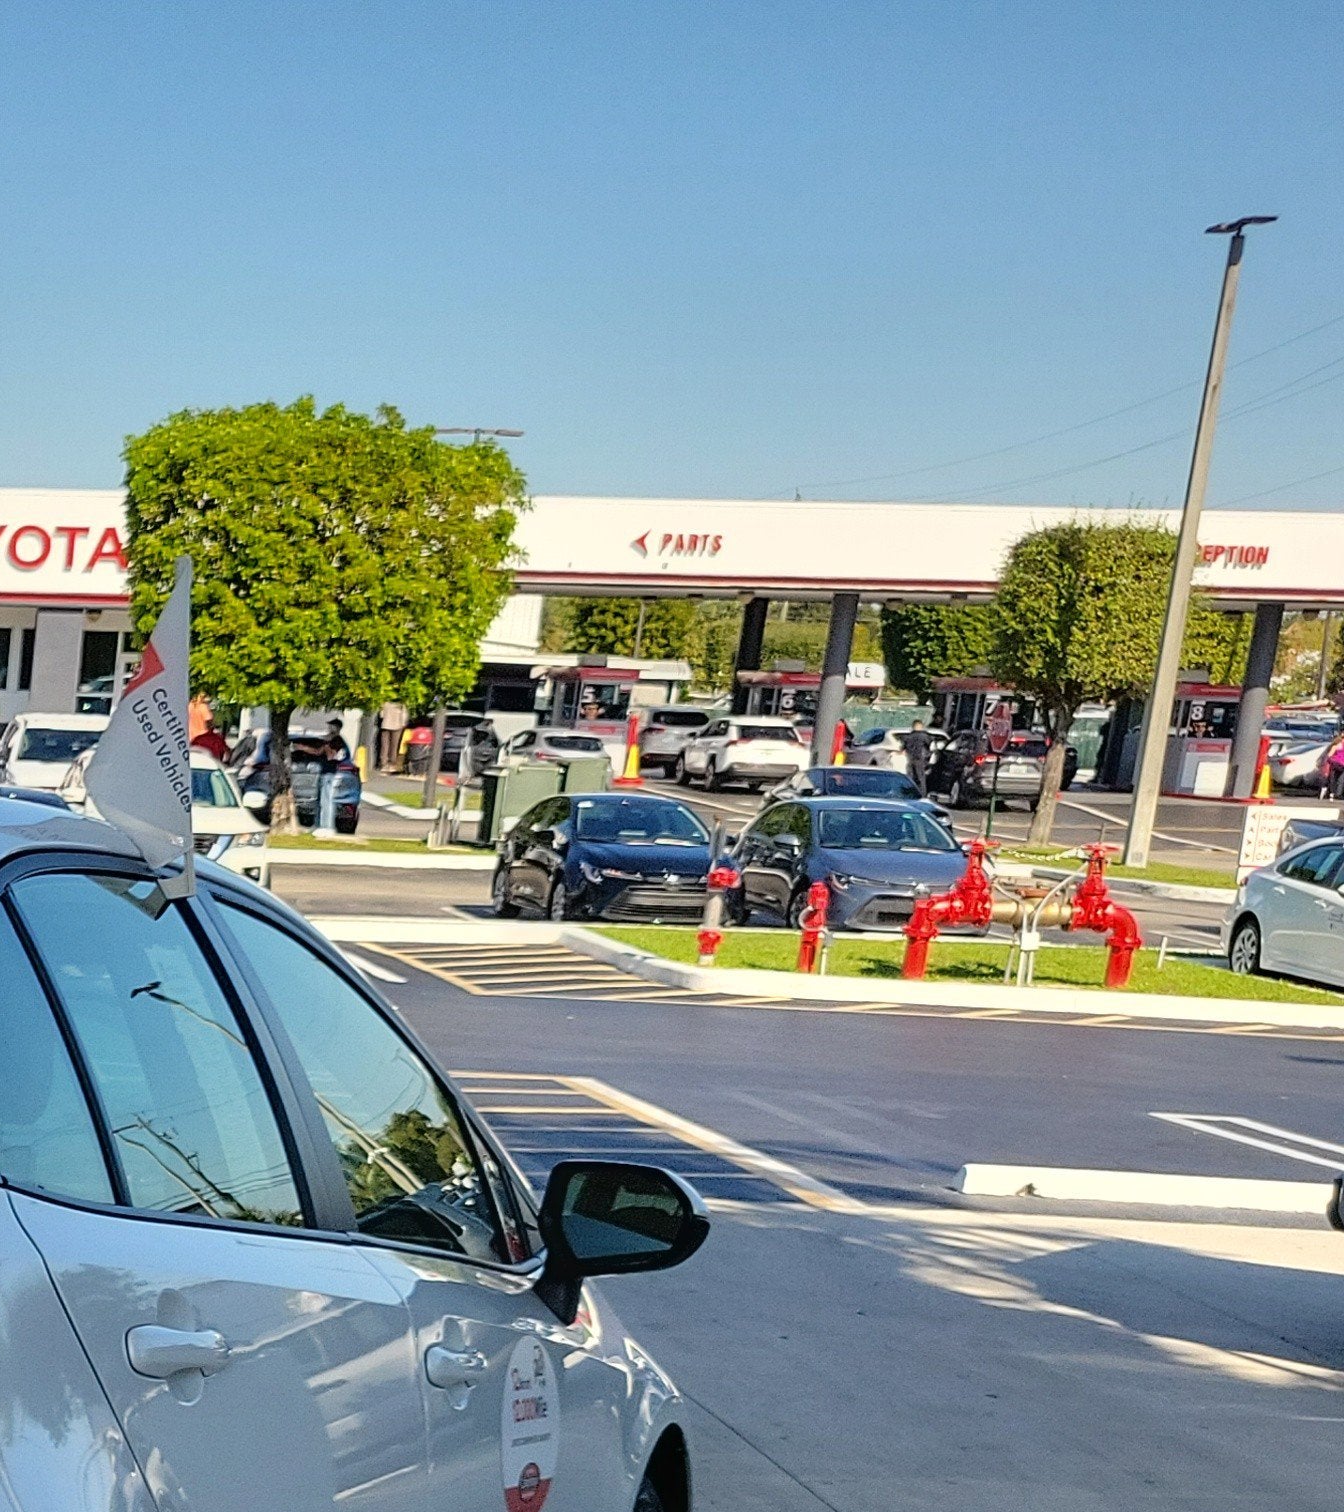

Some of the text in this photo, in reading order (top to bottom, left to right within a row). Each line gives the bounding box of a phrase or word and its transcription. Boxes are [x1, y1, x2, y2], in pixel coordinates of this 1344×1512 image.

[660, 533, 723, 554] PARTS
[132, 699, 164, 744] Used
[1191, 705, 1204, 720] 8
